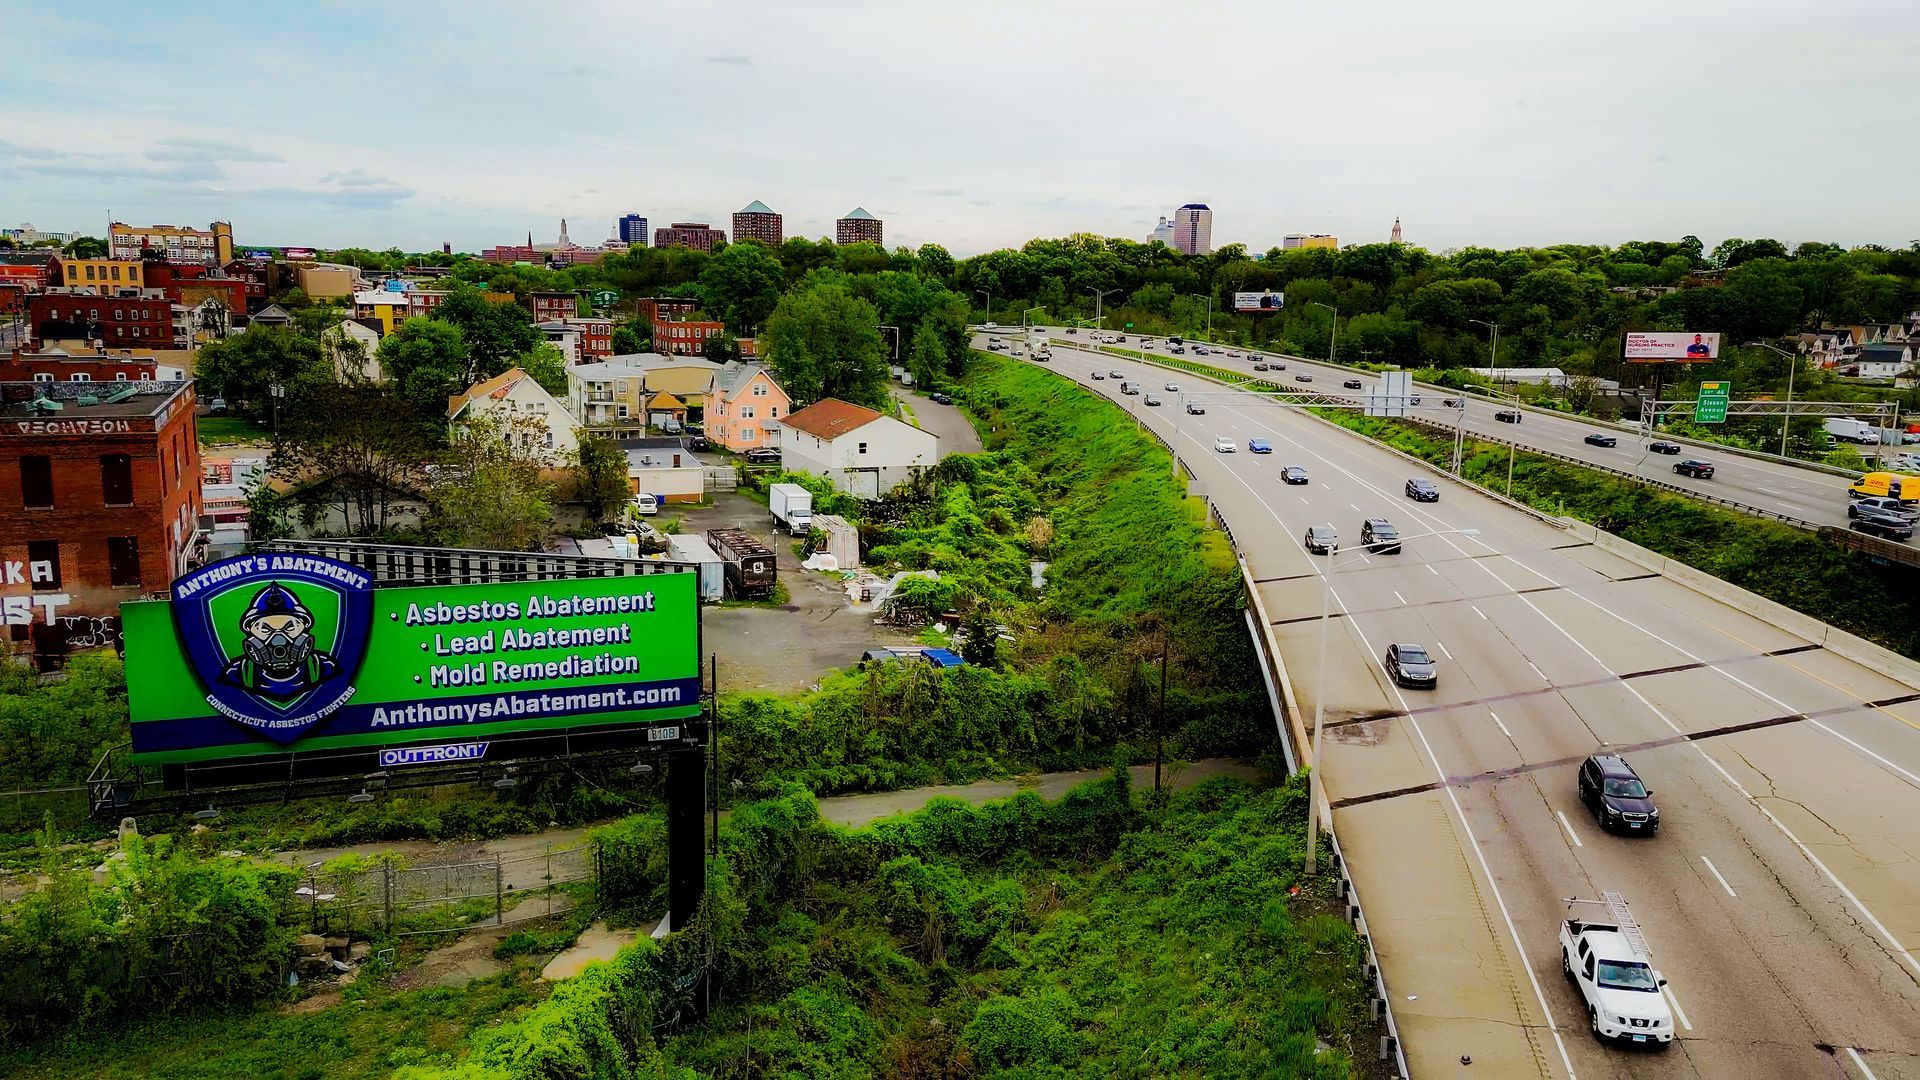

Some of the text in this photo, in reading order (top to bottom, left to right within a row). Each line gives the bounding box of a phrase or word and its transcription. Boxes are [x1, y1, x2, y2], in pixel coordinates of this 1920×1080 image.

[0, 560, 54, 585] KA
[177, 555, 369, 599] ANTHONY'S ABATEMENT
[405, 591, 655, 627] Asbestos Abatement
[435, 622, 631, 656] Lead Abatement
[430, 652, 640, 687] Mold Remediation
[205, 685, 357, 728] CONNECTICUT ASBESTOS FIGHTERS
[370, 686, 681, 727] AnthonysAbatement.com
[384, 744, 483, 764] OUTFRONT
